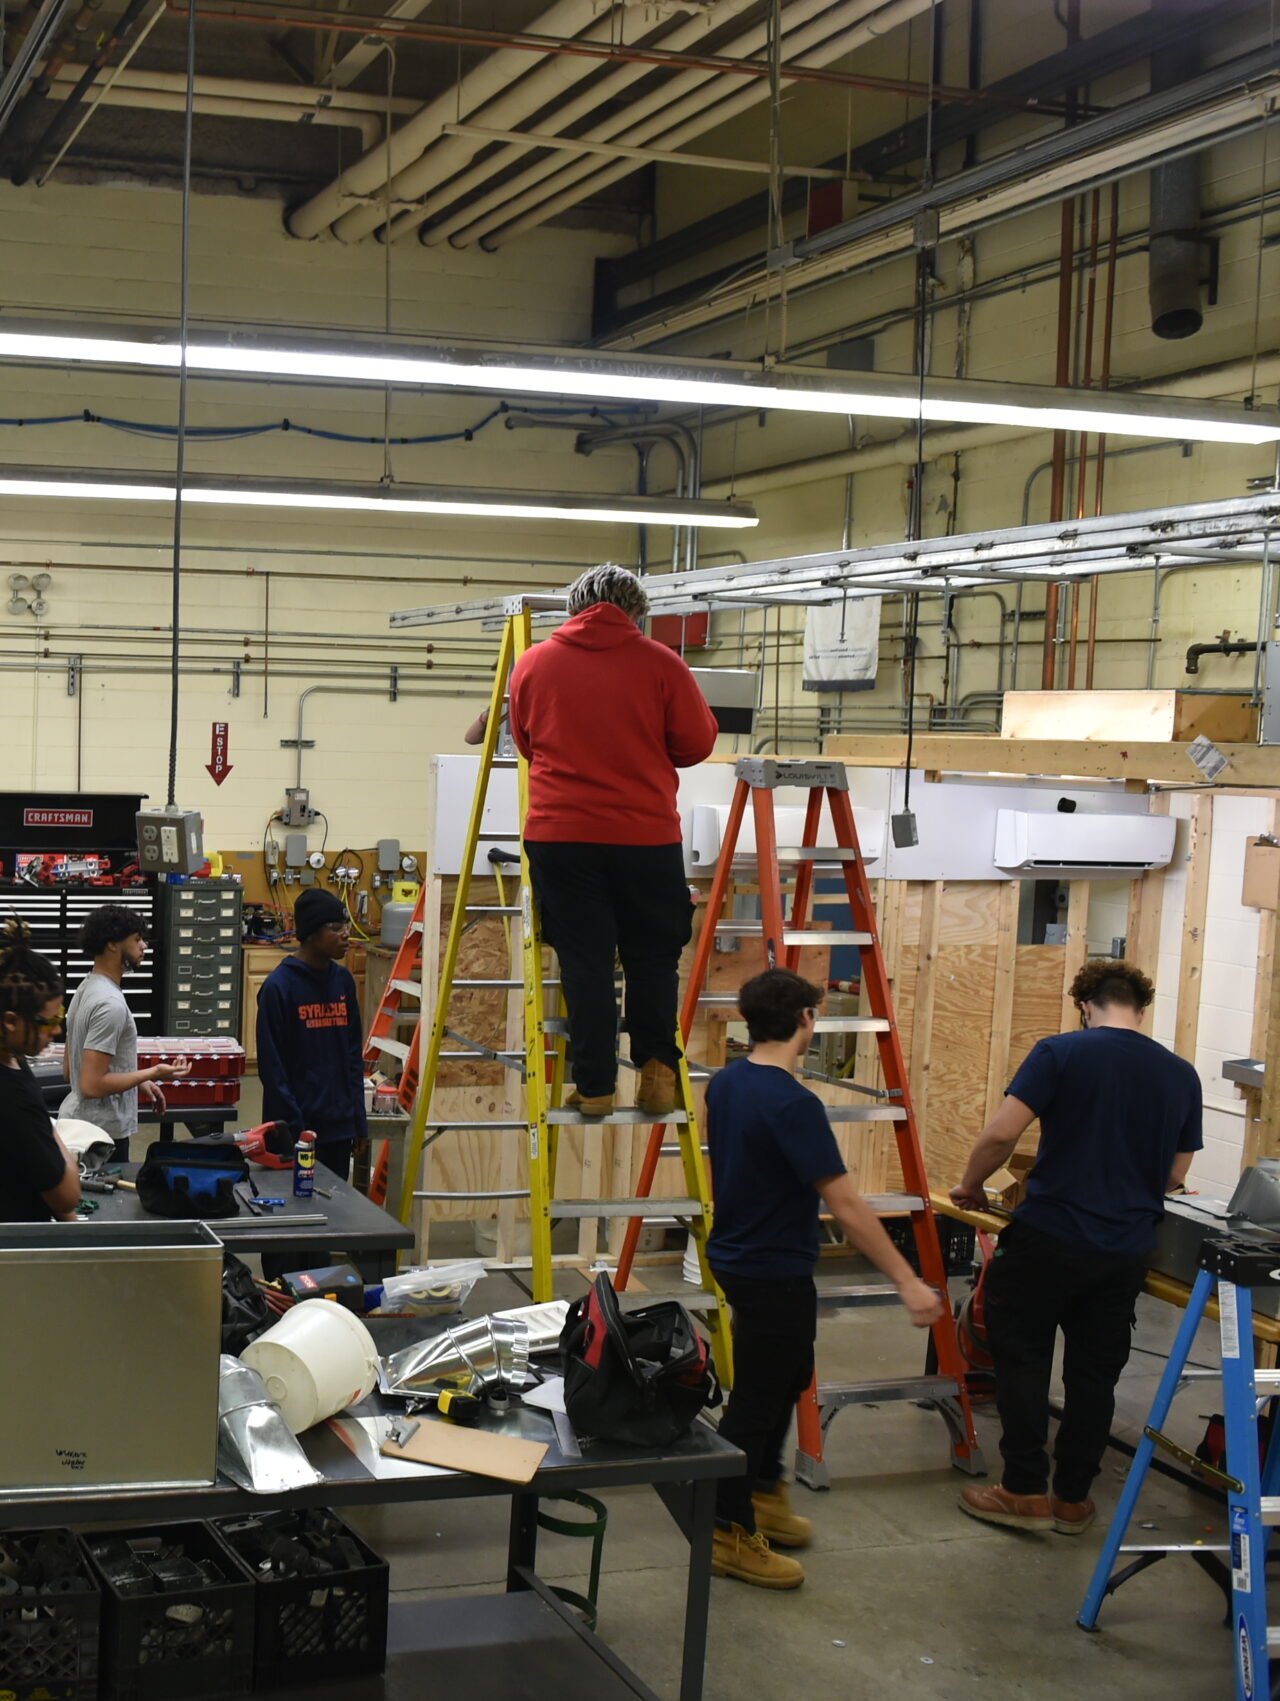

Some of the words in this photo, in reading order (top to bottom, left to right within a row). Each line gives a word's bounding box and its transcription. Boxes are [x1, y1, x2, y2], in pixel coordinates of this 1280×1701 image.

[215, 723, 225, 735] E
[216, 737, 224, 774] STOP
[27, 812, 89, 823] CRAFTSMAN
[1240, 1634, 1252, 1693] WERNER
